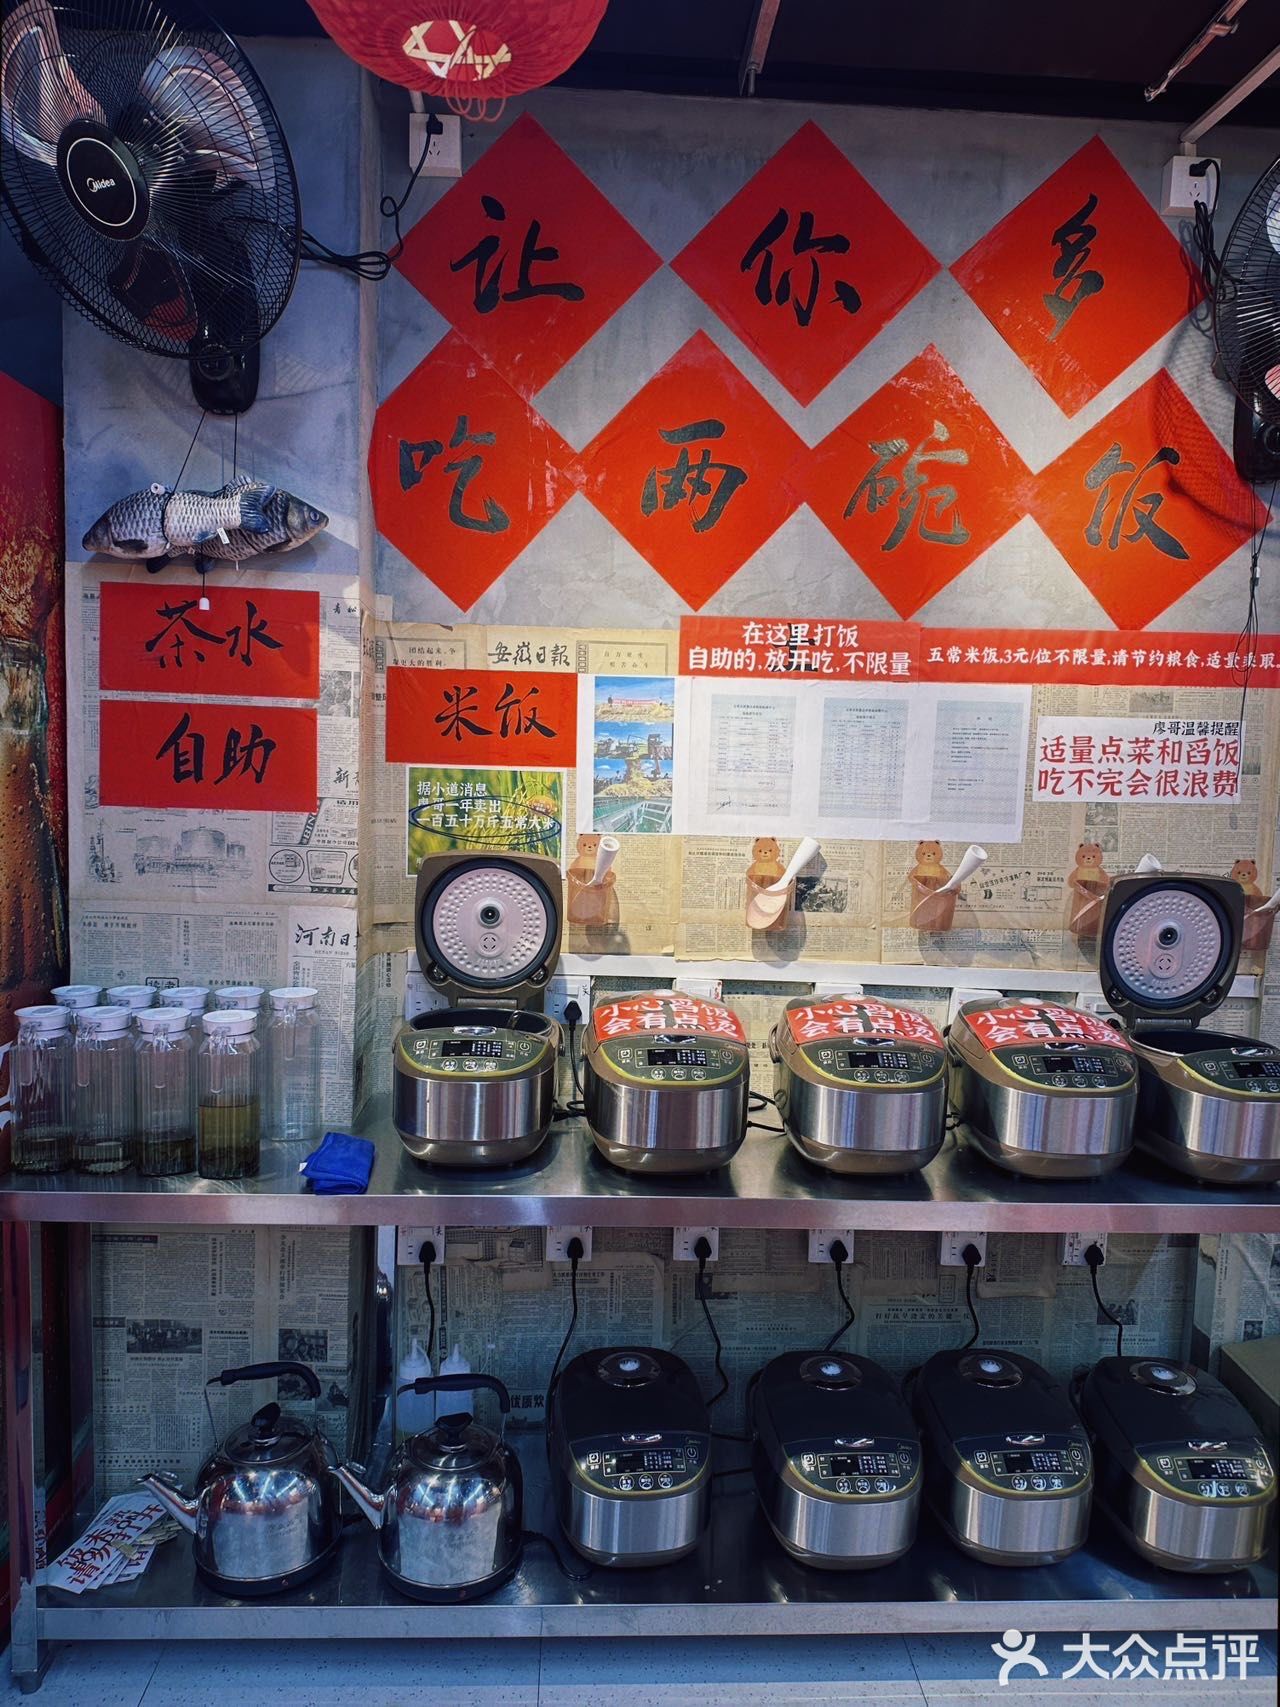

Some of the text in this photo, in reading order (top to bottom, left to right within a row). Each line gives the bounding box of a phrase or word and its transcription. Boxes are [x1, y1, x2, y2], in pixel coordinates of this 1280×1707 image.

[86, 177, 116, 193] Midea
[450, 193, 1104, 342] 让 你 多
[399, 415, 1190, 559] 吃 两 碗 饭
[145, 600, 284, 668] 茶水
[742, 621, 860, 648] 在这里打饭
[434, 683, 557, 741] 米饭
[1152, 720, 1240, 736] 廖哥温馨提醒
[155, 712, 276, 786] 自助
[1039, 735, 1240, 767] 适量点菜和舀饭
[416, 781, 488, 796] 据小道消息
[1037, 767, 1238, 798] 吃不完会很浪费
[416, 814, 555, 830] 一百五十万斤五常大米
[294, 923, 360, 950] 河南日
[600, 999, 733, 1021] 小心舀饭
[795, 1003, 929, 1026] 小心舀饭
[602, 1012, 739, 1037] 会有点烫
[799, 1017, 937, 1044] 会有点烫
